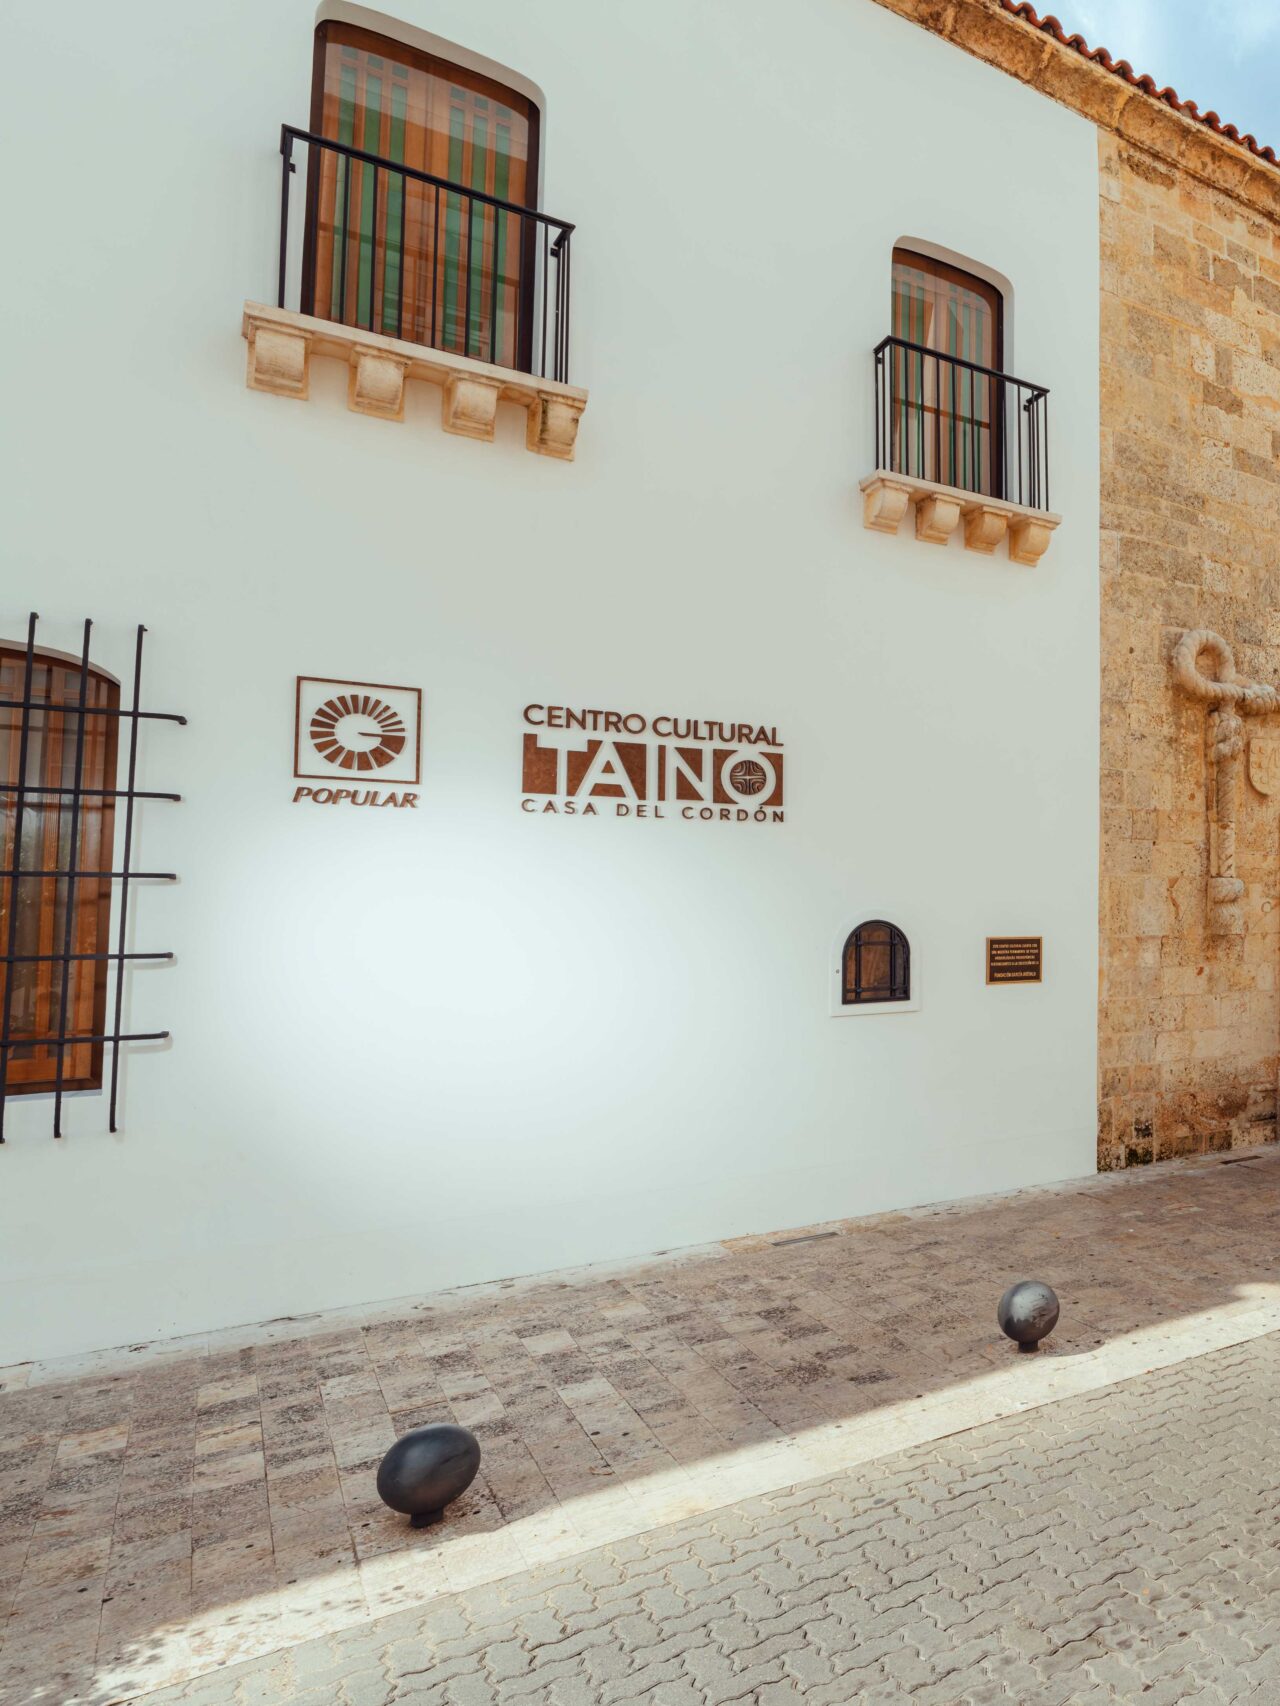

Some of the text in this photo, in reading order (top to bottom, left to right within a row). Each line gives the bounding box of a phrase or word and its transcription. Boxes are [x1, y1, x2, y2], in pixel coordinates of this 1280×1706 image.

[523, 703, 784, 747] CENTRO CULTURAL
[522, 732, 784, 806] TAINO
[292, 786, 420, 808] POPULAR
[521, 798, 785, 823] CASA DEL CORDÓN
